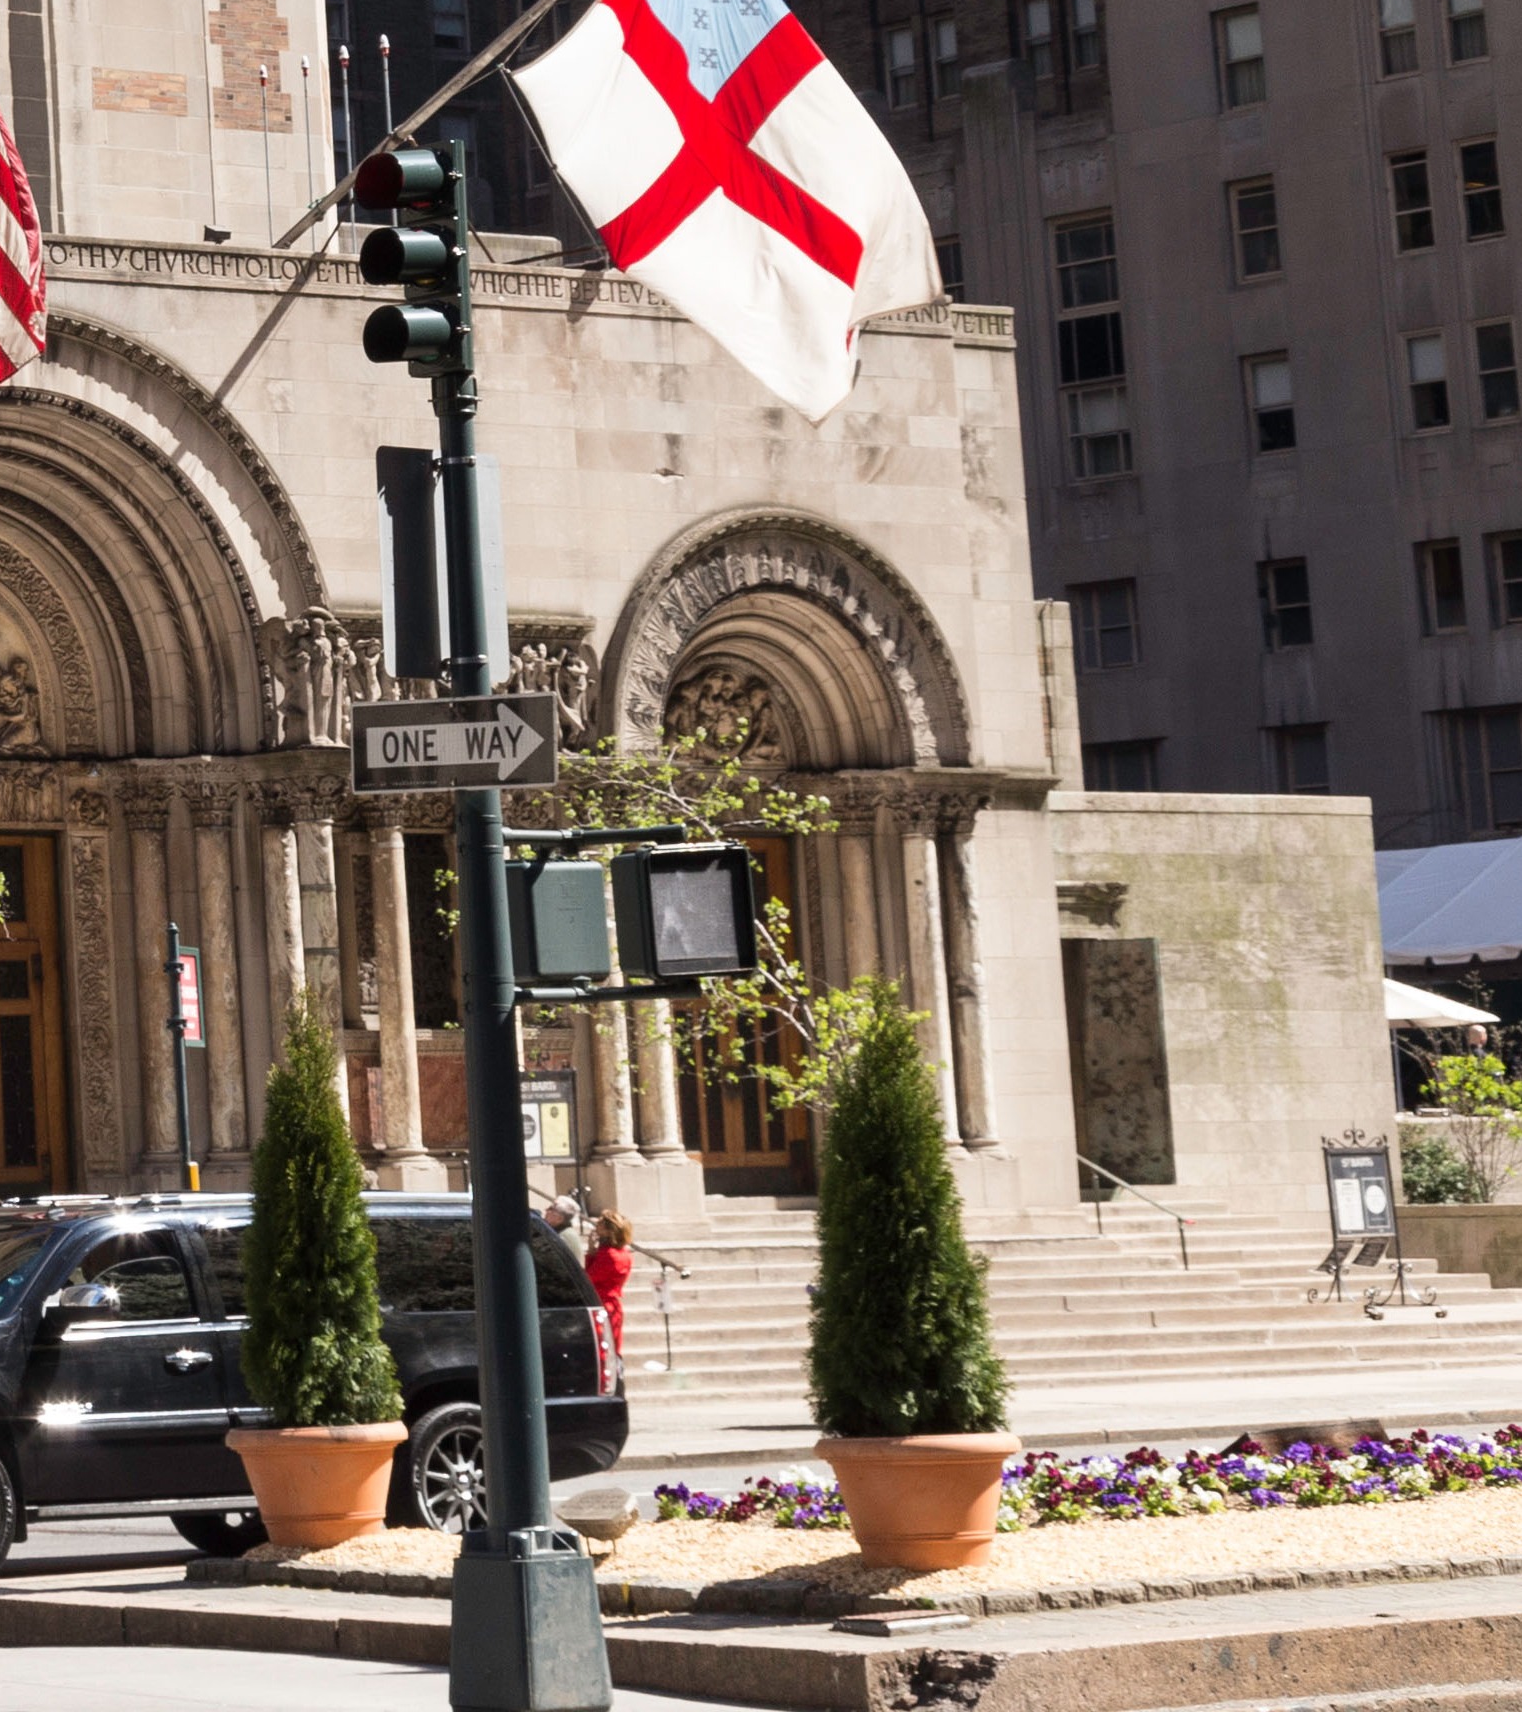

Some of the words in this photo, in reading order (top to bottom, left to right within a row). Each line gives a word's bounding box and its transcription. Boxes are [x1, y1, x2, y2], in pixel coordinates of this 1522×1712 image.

[71, 245, 125, 269] THY
[129, 250, 227, 277] CHVRCH
[231, 256, 263, 278] TO
[268, 258, 329, 282] LOVE
[533, 274, 563, 299] HE
[569, 278, 670, 306] BELIEVE
[382, 729, 438, 763] ONE
[465, 725, 524, 760] WAY
